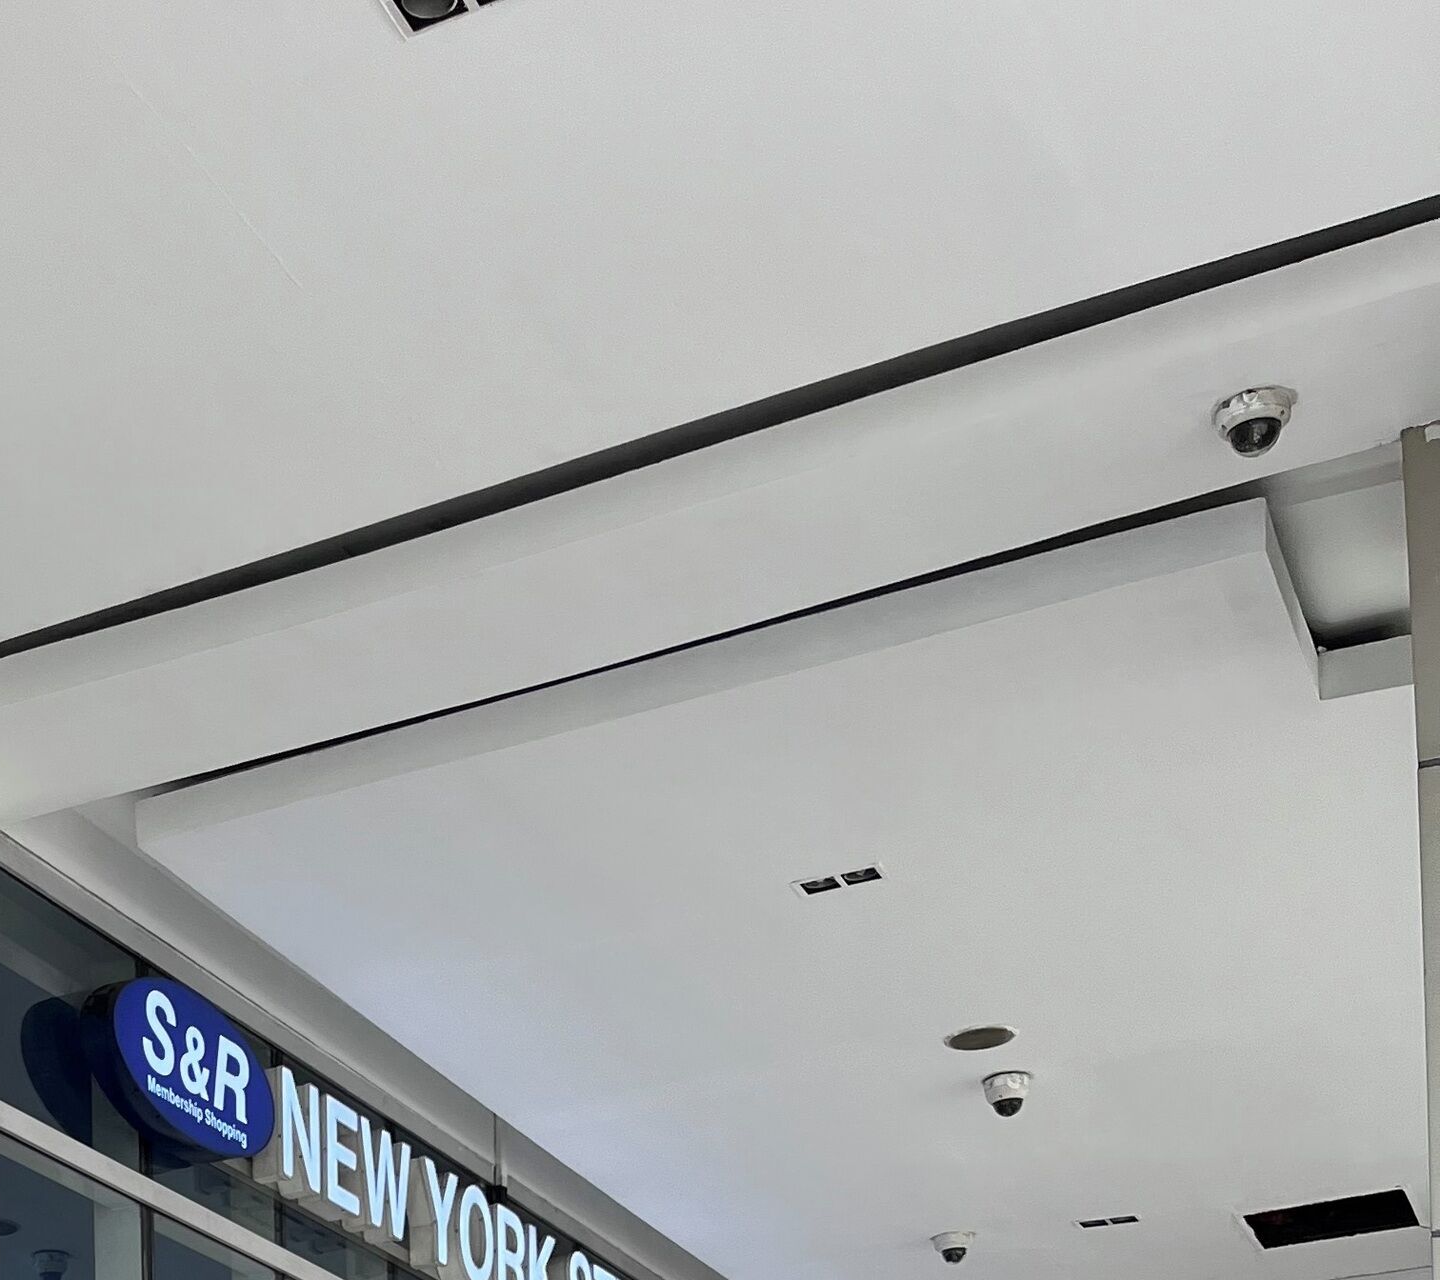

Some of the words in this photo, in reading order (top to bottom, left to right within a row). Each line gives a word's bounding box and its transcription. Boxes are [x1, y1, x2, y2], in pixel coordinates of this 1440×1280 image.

[143, 989, 249, 1125] S&R
[147, 1074, 203, 1124] Membership
[204, 1108, 248, 1150] Shopping
[281, 1066, 410, 1242] NEW
